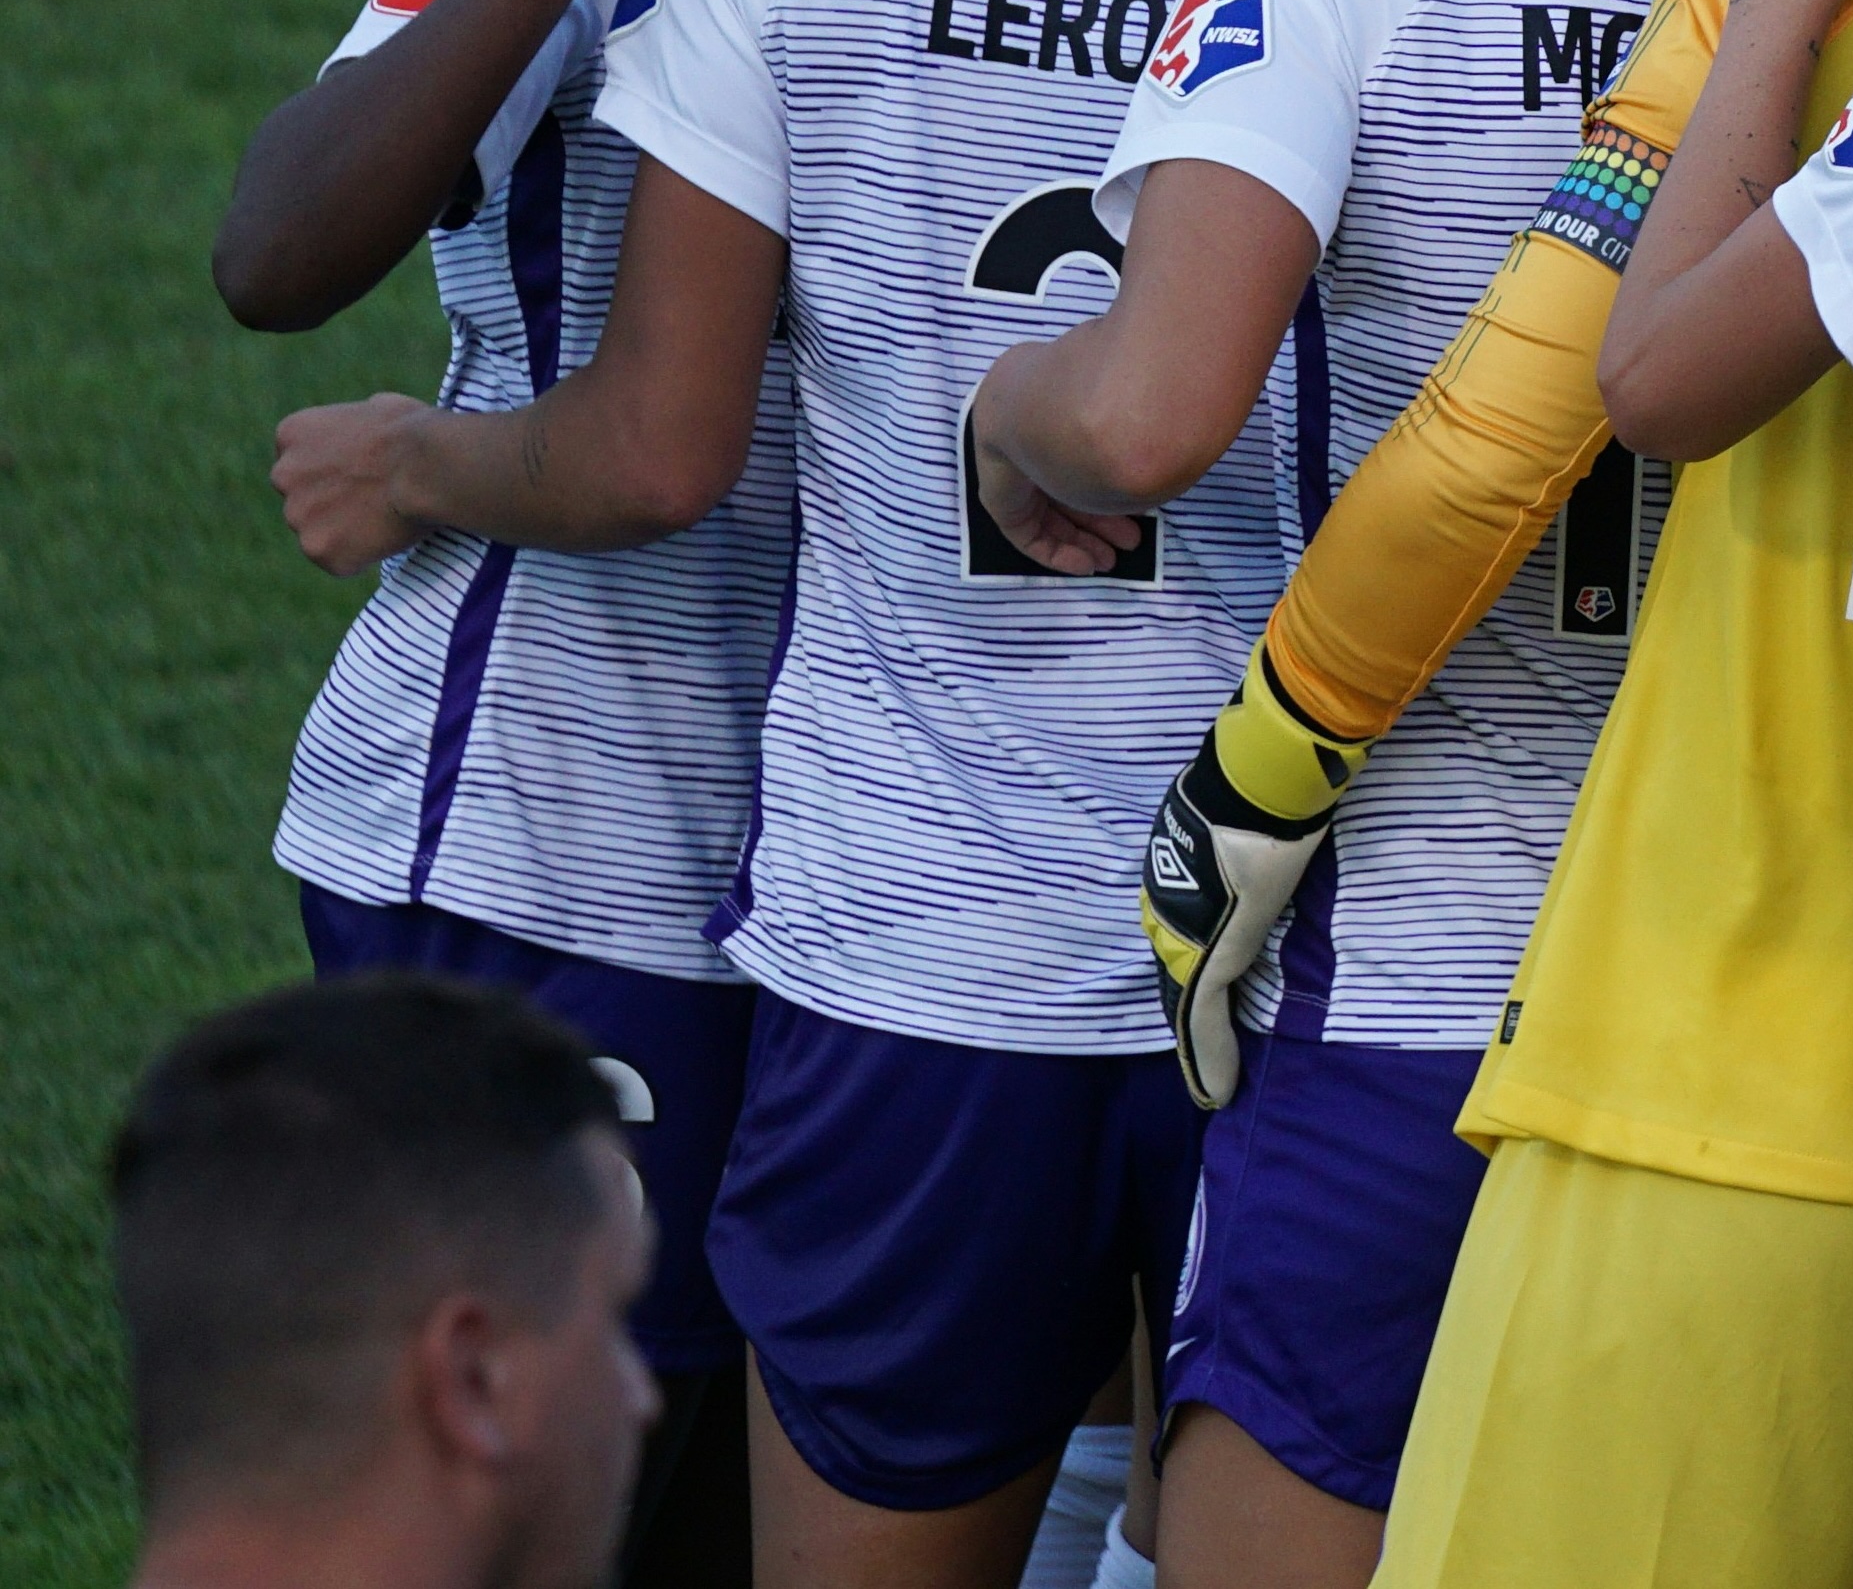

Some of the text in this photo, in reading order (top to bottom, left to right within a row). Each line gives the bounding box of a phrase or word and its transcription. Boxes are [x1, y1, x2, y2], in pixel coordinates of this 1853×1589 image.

[1201, 26, 1260, 47] NWSL
[1534, 210, 1558, 229] IN
[1554, 214, 1600, 248] OUR
